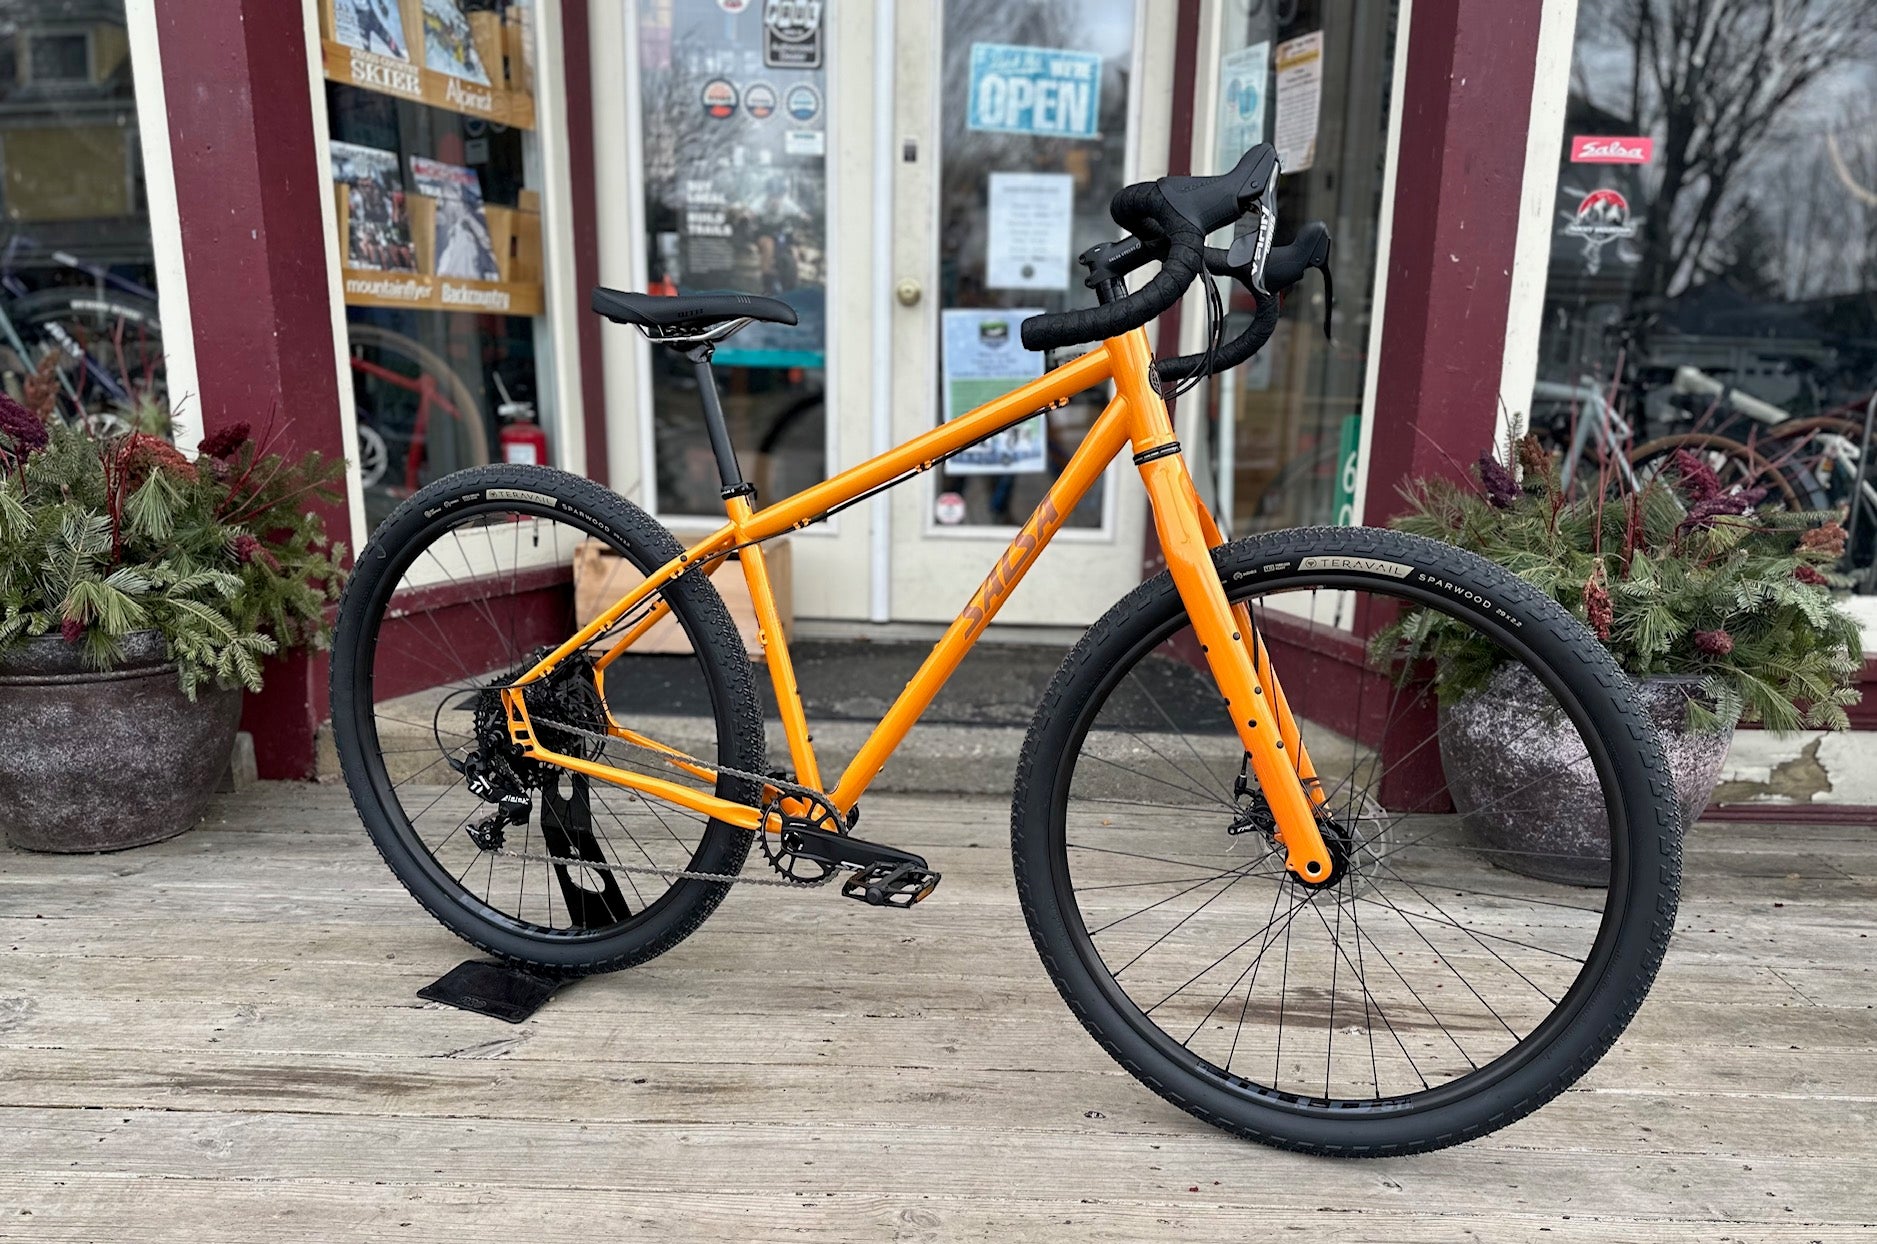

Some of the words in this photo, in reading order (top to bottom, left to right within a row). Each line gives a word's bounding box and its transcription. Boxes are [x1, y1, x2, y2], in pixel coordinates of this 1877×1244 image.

[351, 59, 421, 96] SKIER
[979, 72, 1089, 132] OPEN
[1577, 141, 1645, 160] Salsa
[500, 490, 553, 506] TERAVAIL
[561, 503, 610, 532] SPARWOOD
[962, 491, 1059, 641] SALSA
[1320, 558, 1404, 577] TERAVAIL
[1418, 573, 1492, 609] SPARWOOD
